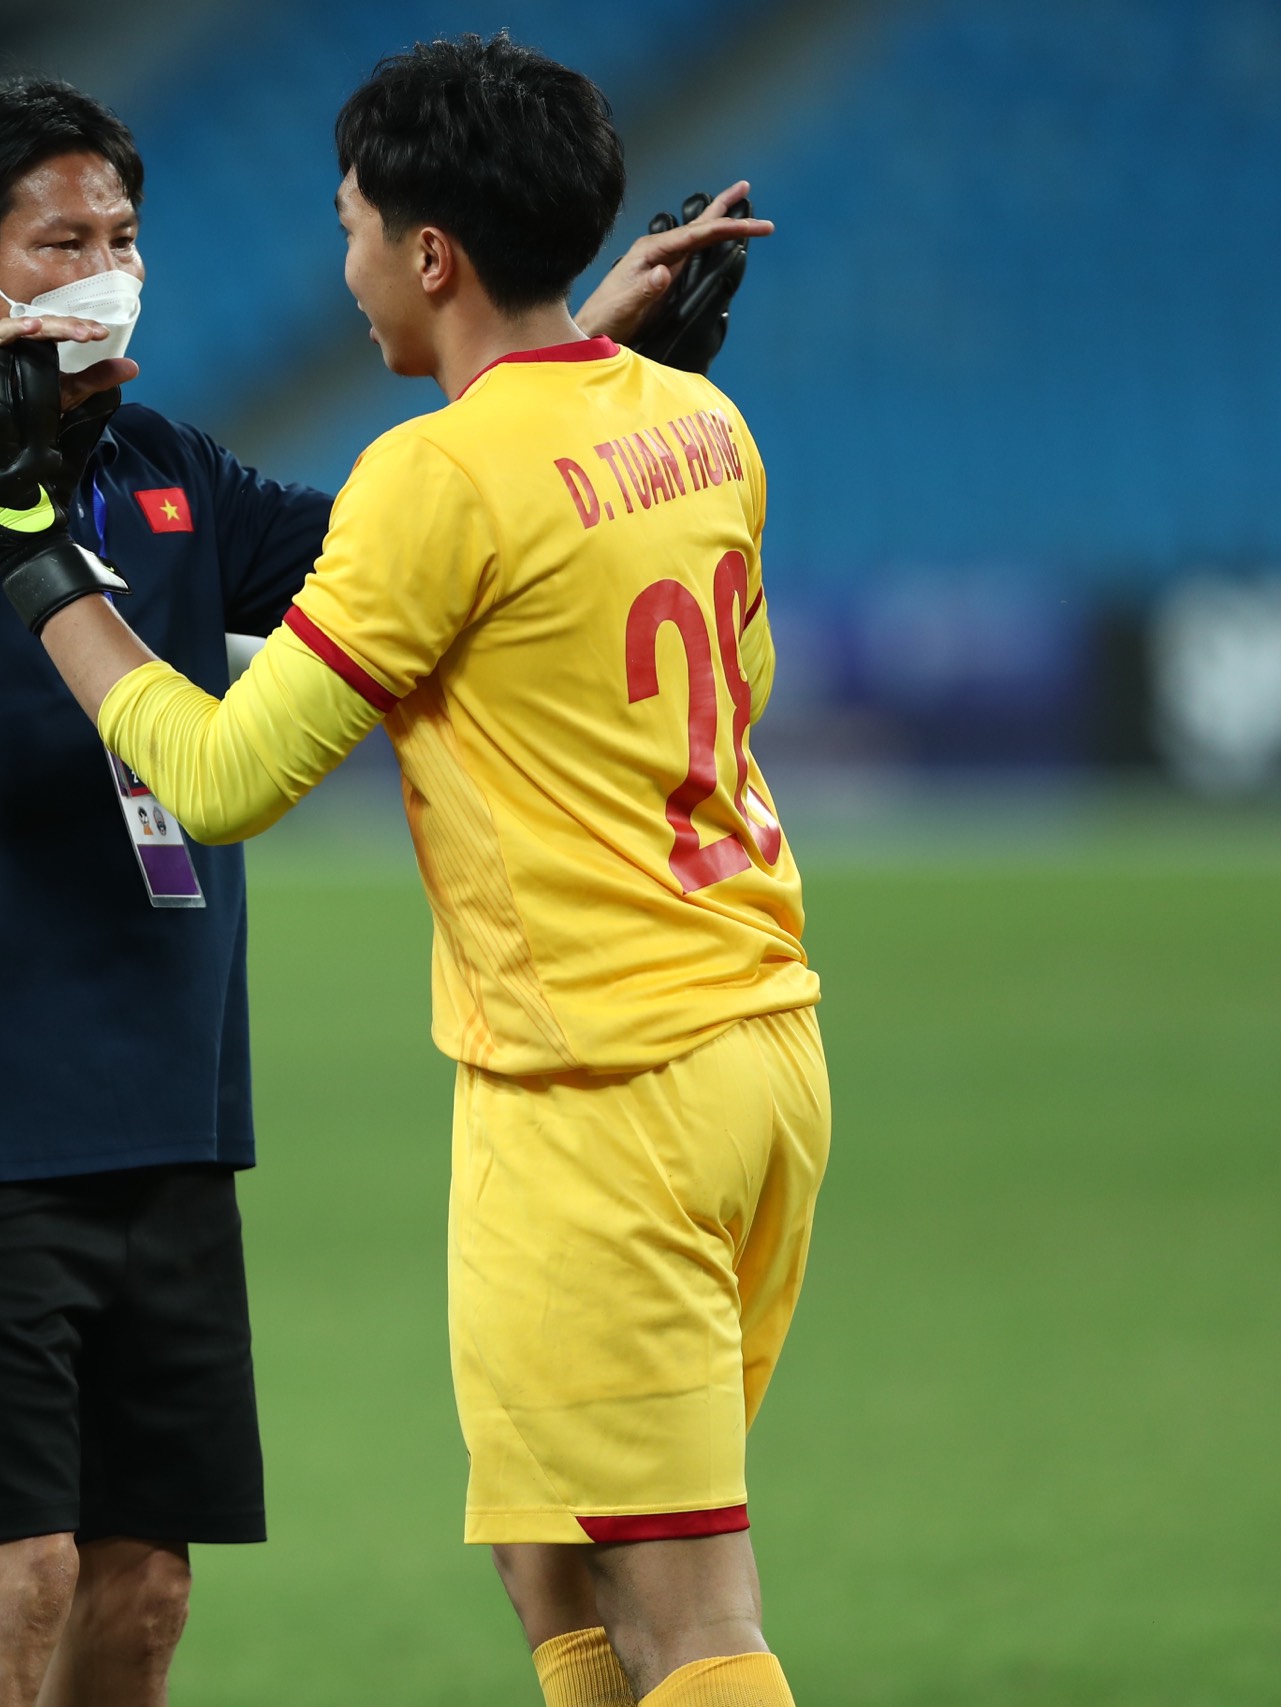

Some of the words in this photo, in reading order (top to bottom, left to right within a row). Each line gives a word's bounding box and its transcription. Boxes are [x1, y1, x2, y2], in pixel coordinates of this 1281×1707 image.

[553, 457, 615, 530] D.
[593, 426, 687, 514] TUAN
[625, 550, 782, 896] 28
